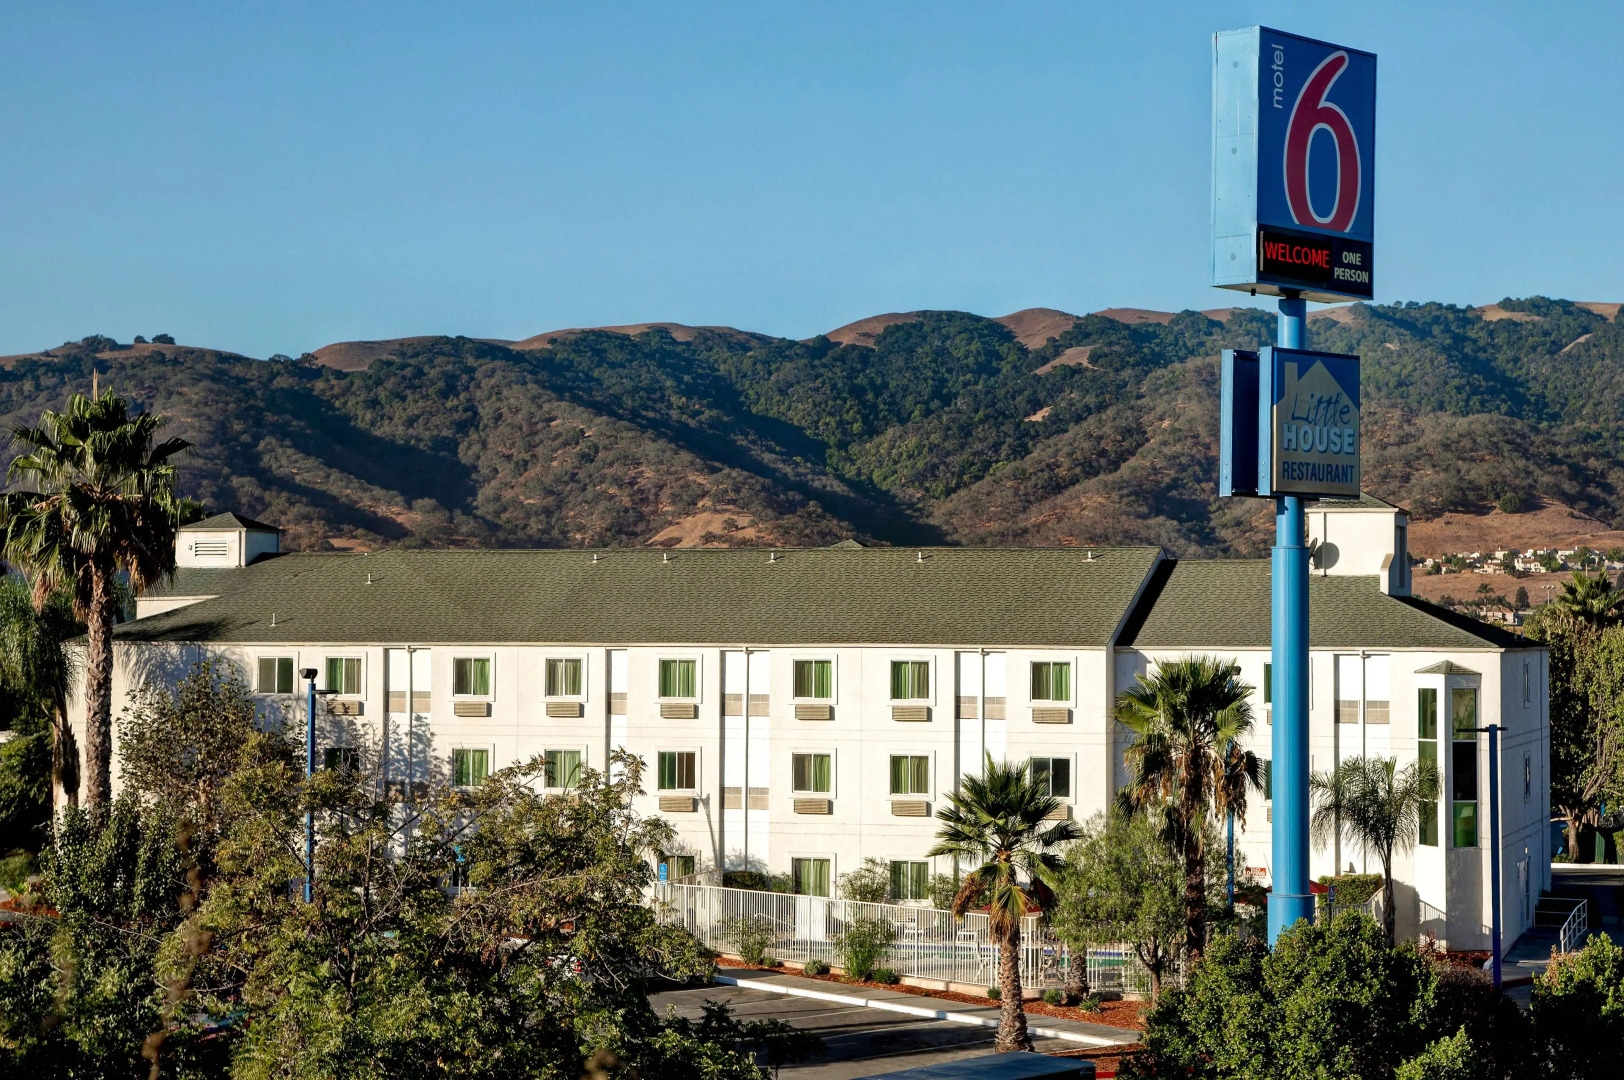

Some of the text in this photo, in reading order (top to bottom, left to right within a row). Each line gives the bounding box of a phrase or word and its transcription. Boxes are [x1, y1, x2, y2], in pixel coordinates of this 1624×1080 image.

[1271, 44, 1284, 109] motel
[1283, 50, 1362, 233] 6
[1265, 241, 1331, 269] WELCOME
[1342, 251, 1362, 266] ONE
[1334, 267, 1369, 283] PERSON
[1291, 392, 1351, 427] Little
[1283, 424, 1356, 455] HOUSE
[1282, 461, 1355, 483] RESTAURANT
